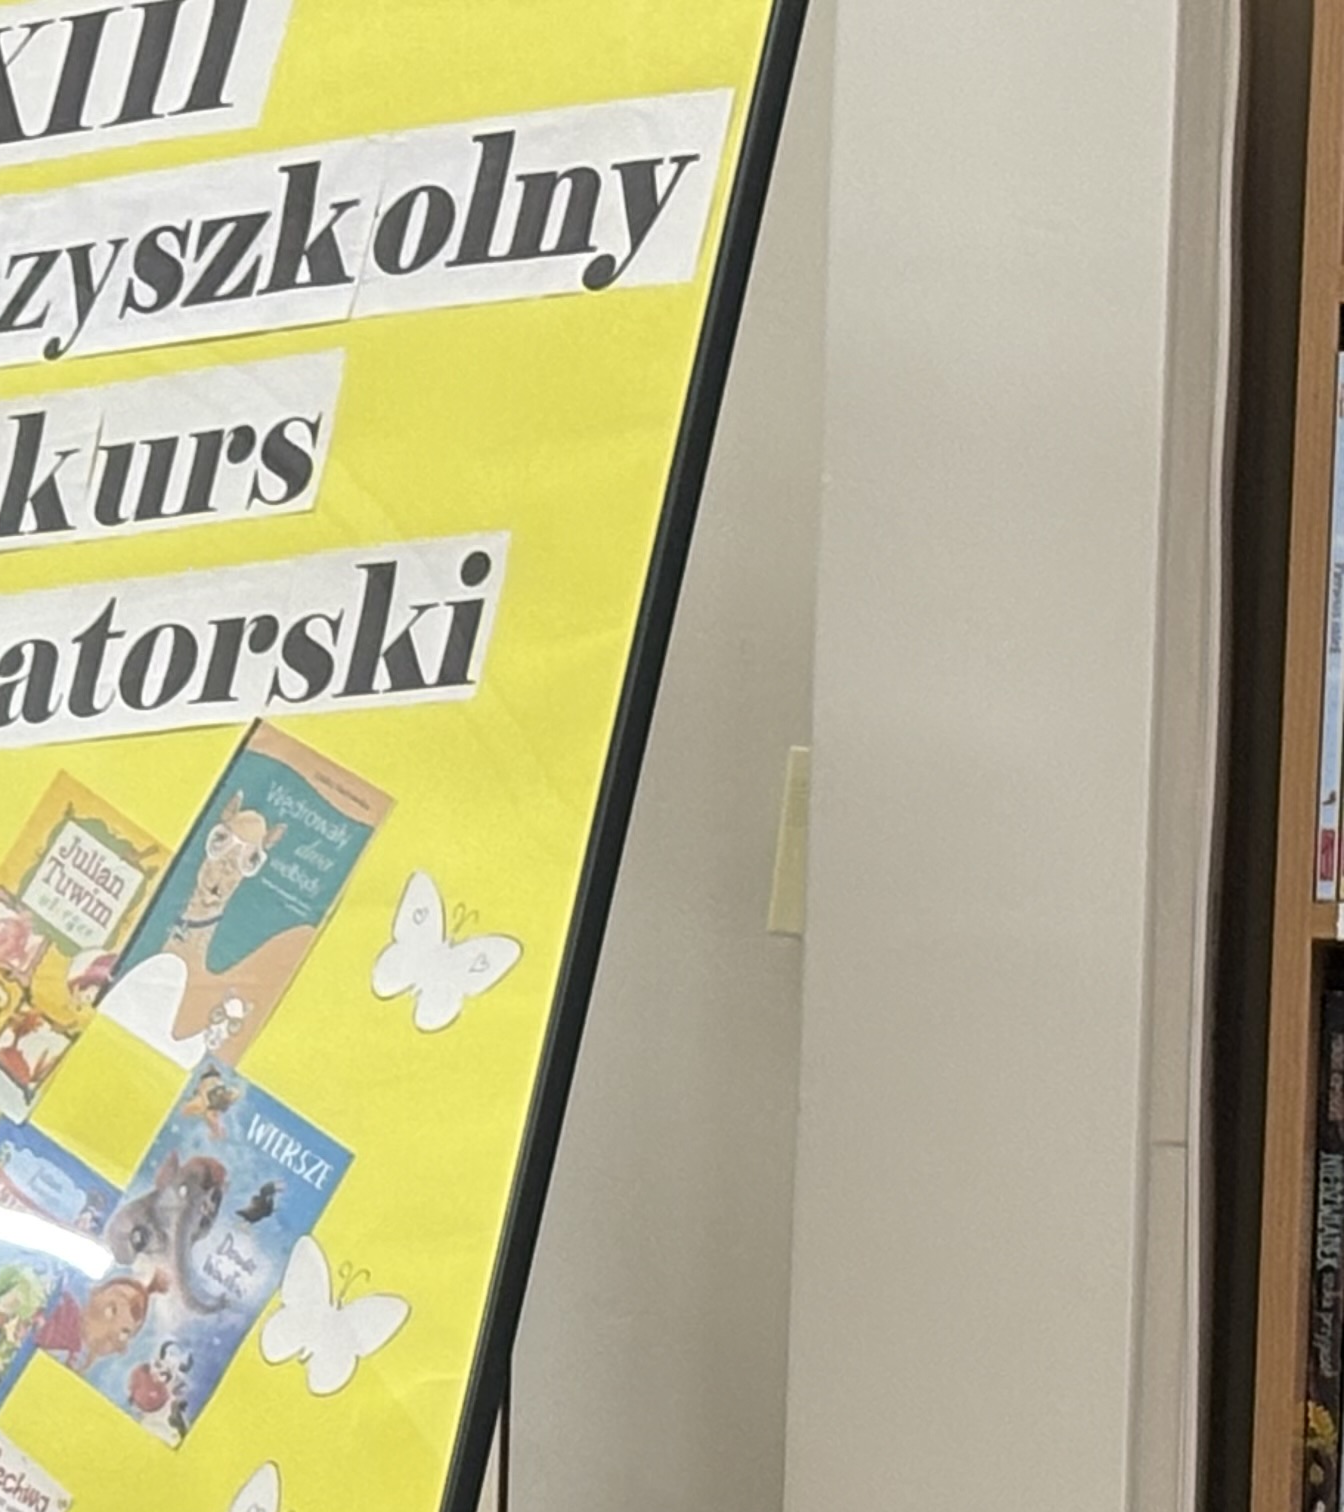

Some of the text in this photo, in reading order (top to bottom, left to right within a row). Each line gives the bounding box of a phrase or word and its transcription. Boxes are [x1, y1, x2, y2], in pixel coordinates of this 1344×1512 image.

[41, 857, 115, 930] Tuwim
[58, 832, 126, 902] Julian
[246, 1112, 335, 1191] WIERSZE
